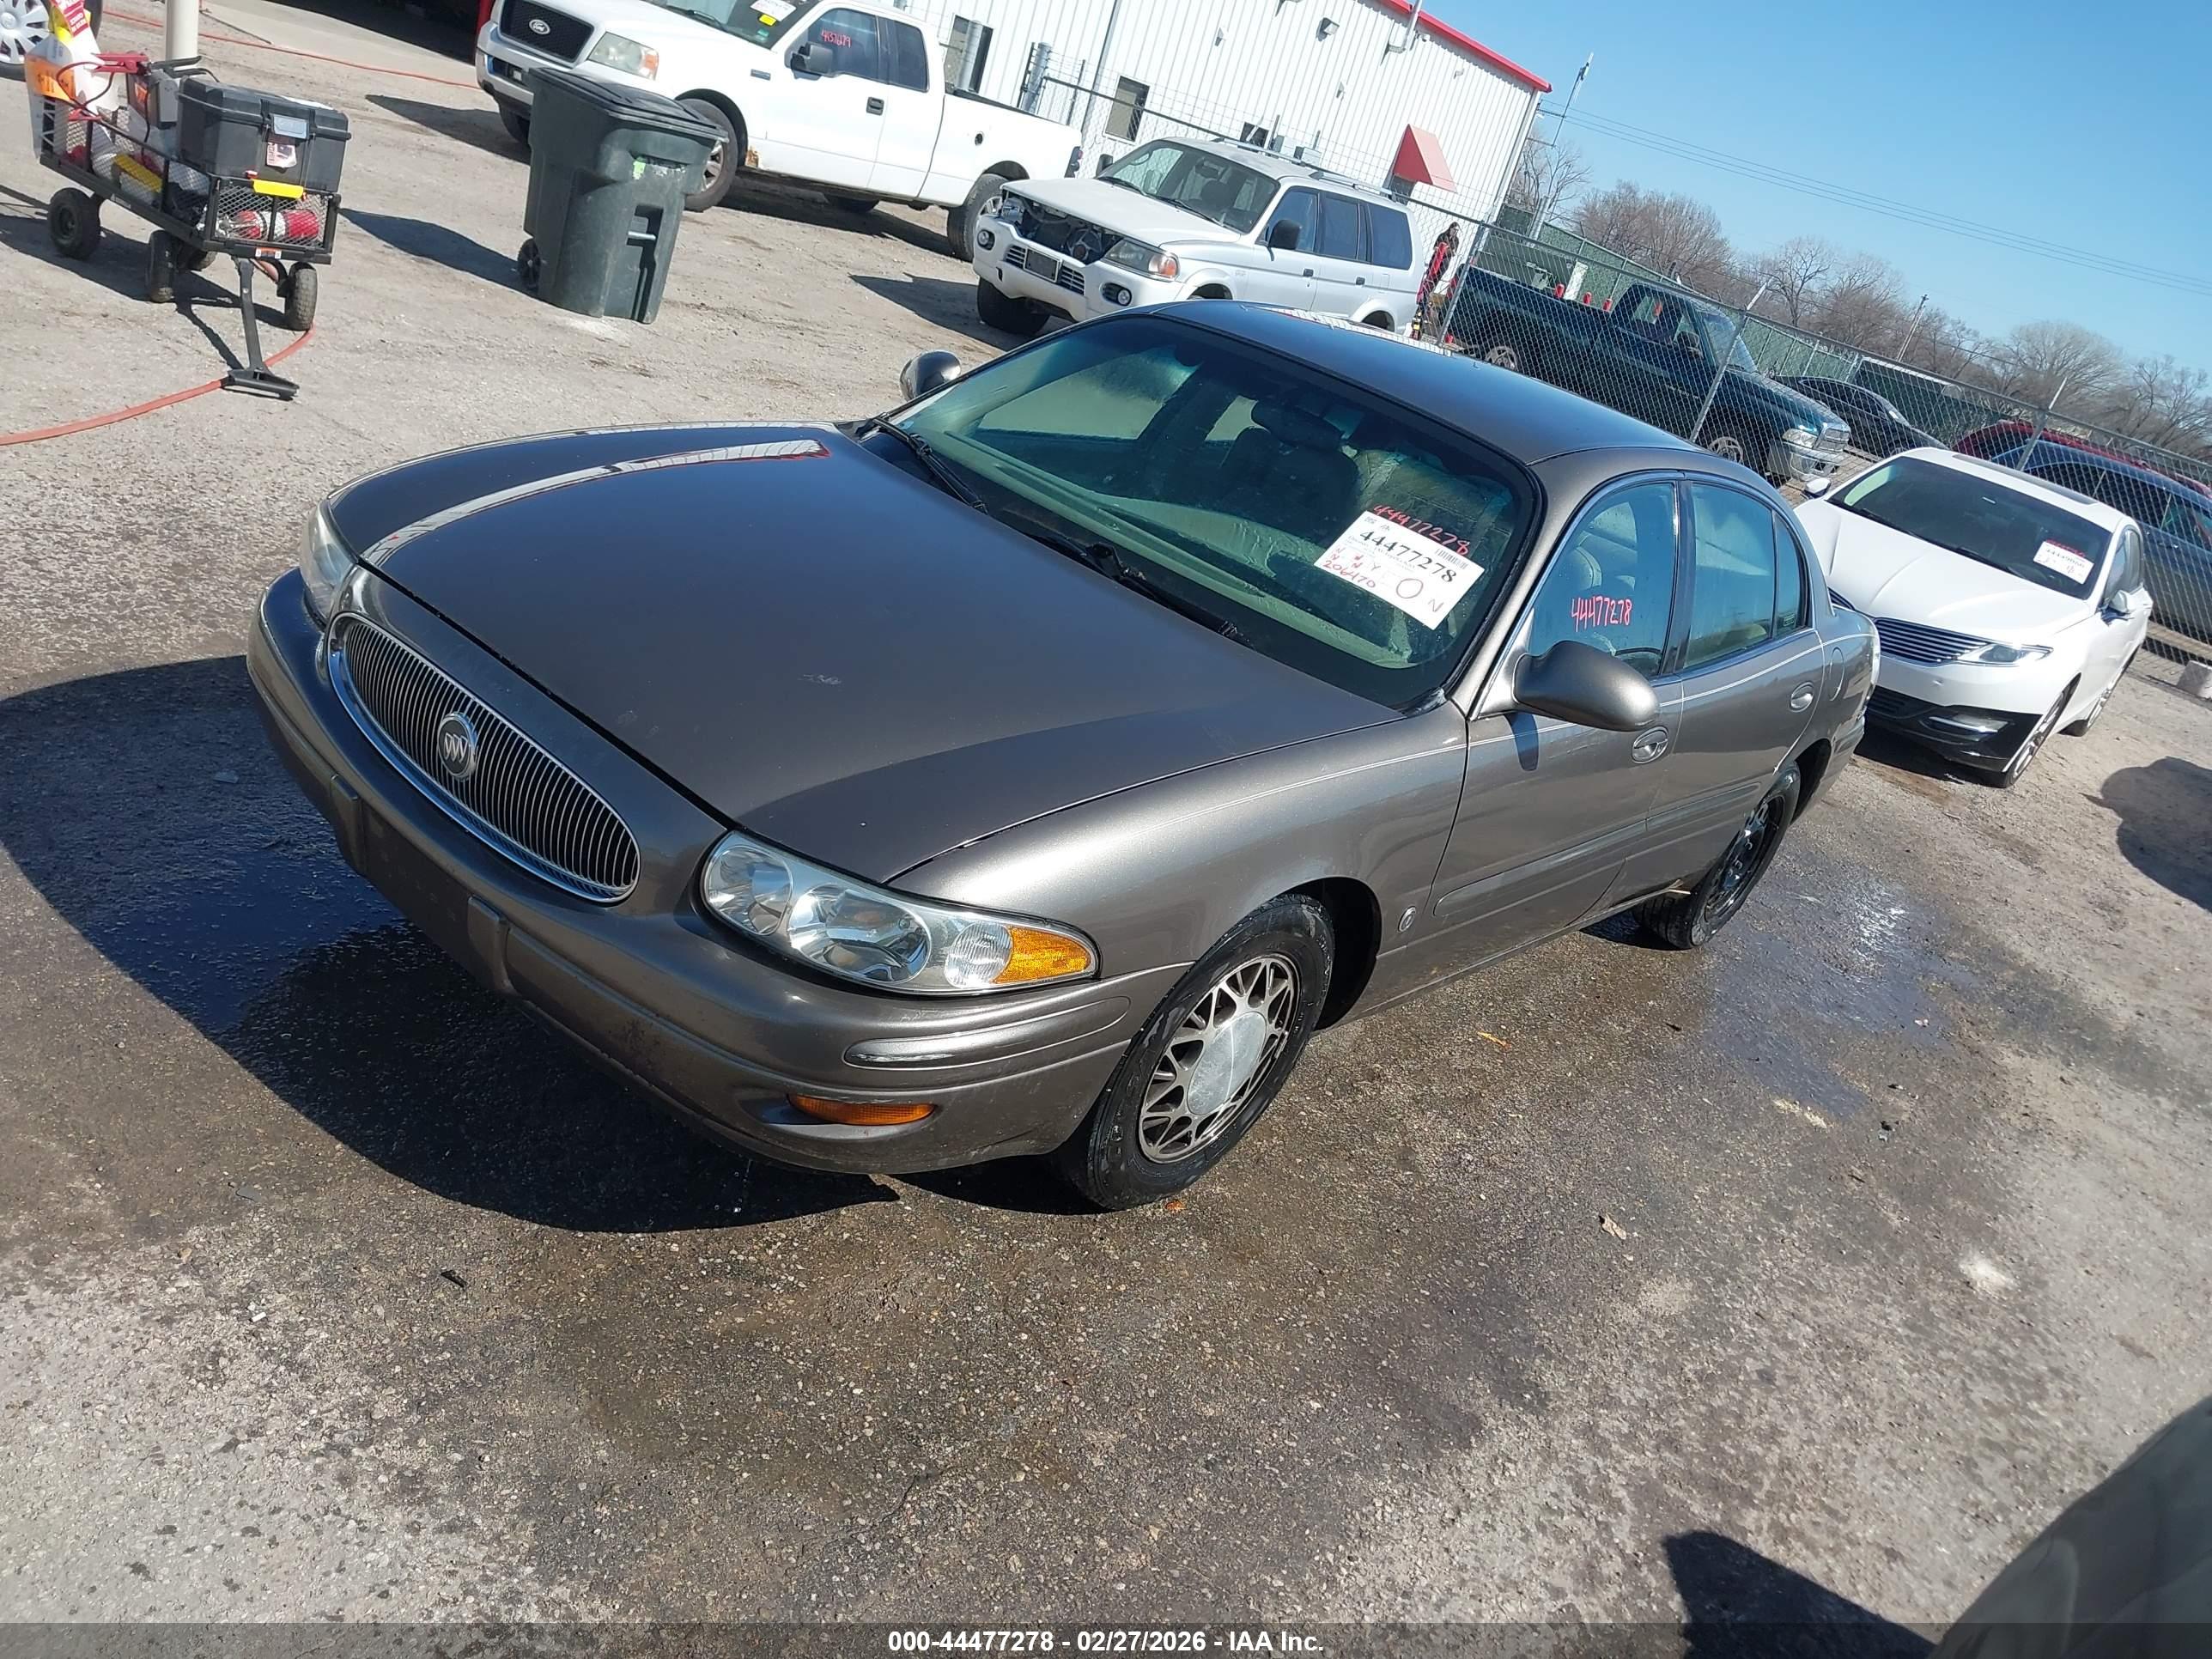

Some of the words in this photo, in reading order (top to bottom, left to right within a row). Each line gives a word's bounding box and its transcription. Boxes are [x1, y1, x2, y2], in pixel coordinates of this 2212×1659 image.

[1373, 504, 1470, 556] 44477278
[1359, 531, 1457, 583] 44477278
[1571, 595, 1633, 633] 44477278
